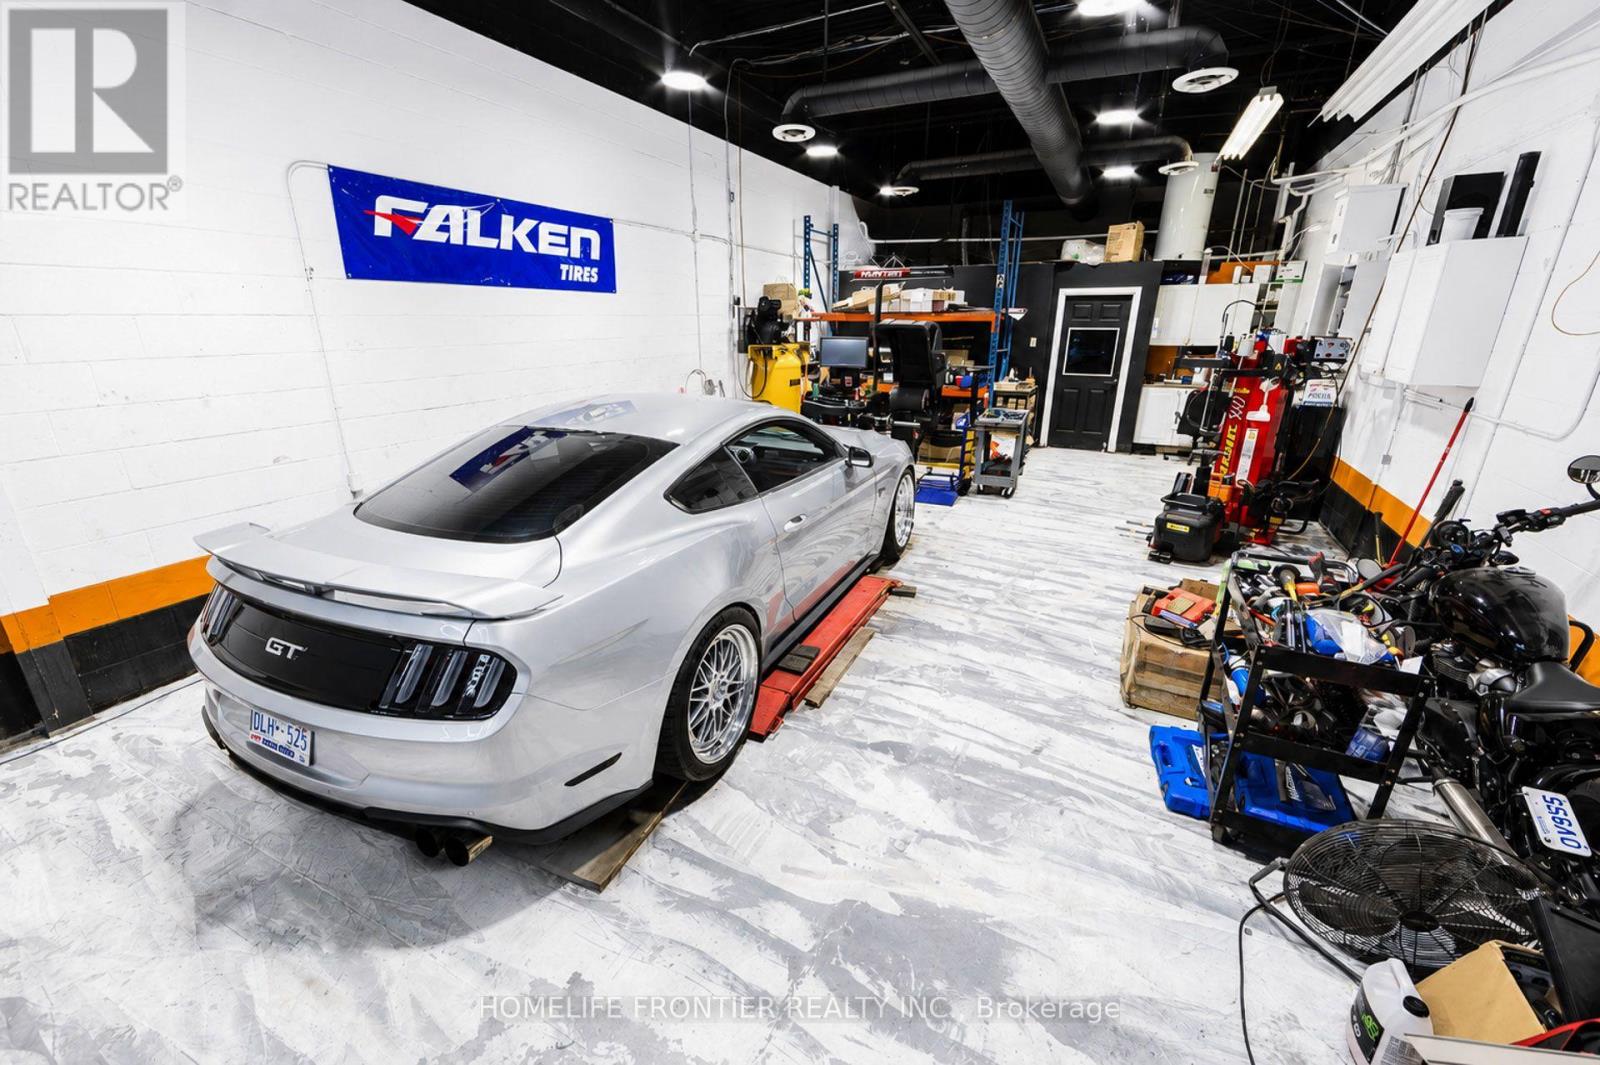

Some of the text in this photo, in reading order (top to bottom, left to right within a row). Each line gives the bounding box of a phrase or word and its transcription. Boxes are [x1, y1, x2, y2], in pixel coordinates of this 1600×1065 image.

[368, 195, 601, 261] FALKEN
[560, 264, 598, 283] TIRES
[265, 637, 306, 660] GT
